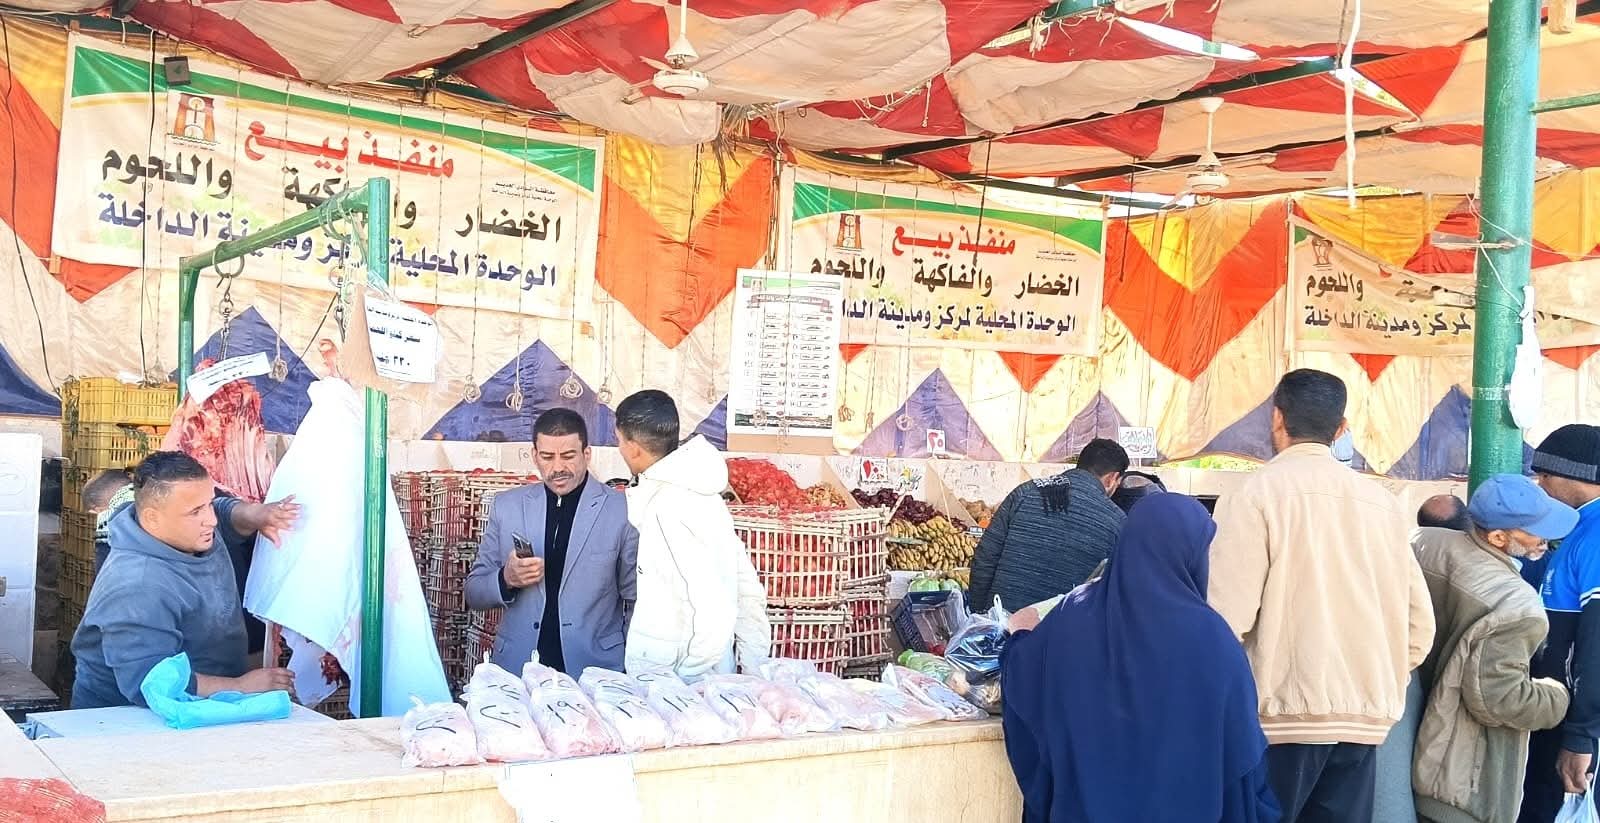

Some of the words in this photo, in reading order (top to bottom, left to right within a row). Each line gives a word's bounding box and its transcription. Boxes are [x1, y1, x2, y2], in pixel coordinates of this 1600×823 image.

[244, 120, 349, 173] بيع
[358, 131, 454, 178] منفذ
[102, 149, 233, 200] واللحوم
[98, 192, 209, 238] الداخلة
[455, 203, 561, 244] الخضار
[892, 226, 954, 260] بيع
[958, 225, 1016, 255] منفذ
[389, 238, 470, 278] المحلية
[475, 253, 556, 291] الوحدة
[913, 257, 993, 298] والفاكهة
[1014, 272, 1079, 299] الخضار
[1306, 271, 1364, 302] واللحوم
[842, 299, 873, 319] الدا
[878, 298, 931, 329] ومدينة
[935, 304, 971, 331] لمركز
[976, 305, 1023, 334] المحلية
[1026, 311, 1076, 336] الوحدة
[1304, 305, 1361, 329] الداخلة
[1363, 309, 1421, 338] ومدينة
[1423, 311, 1472, 336] لمركز
